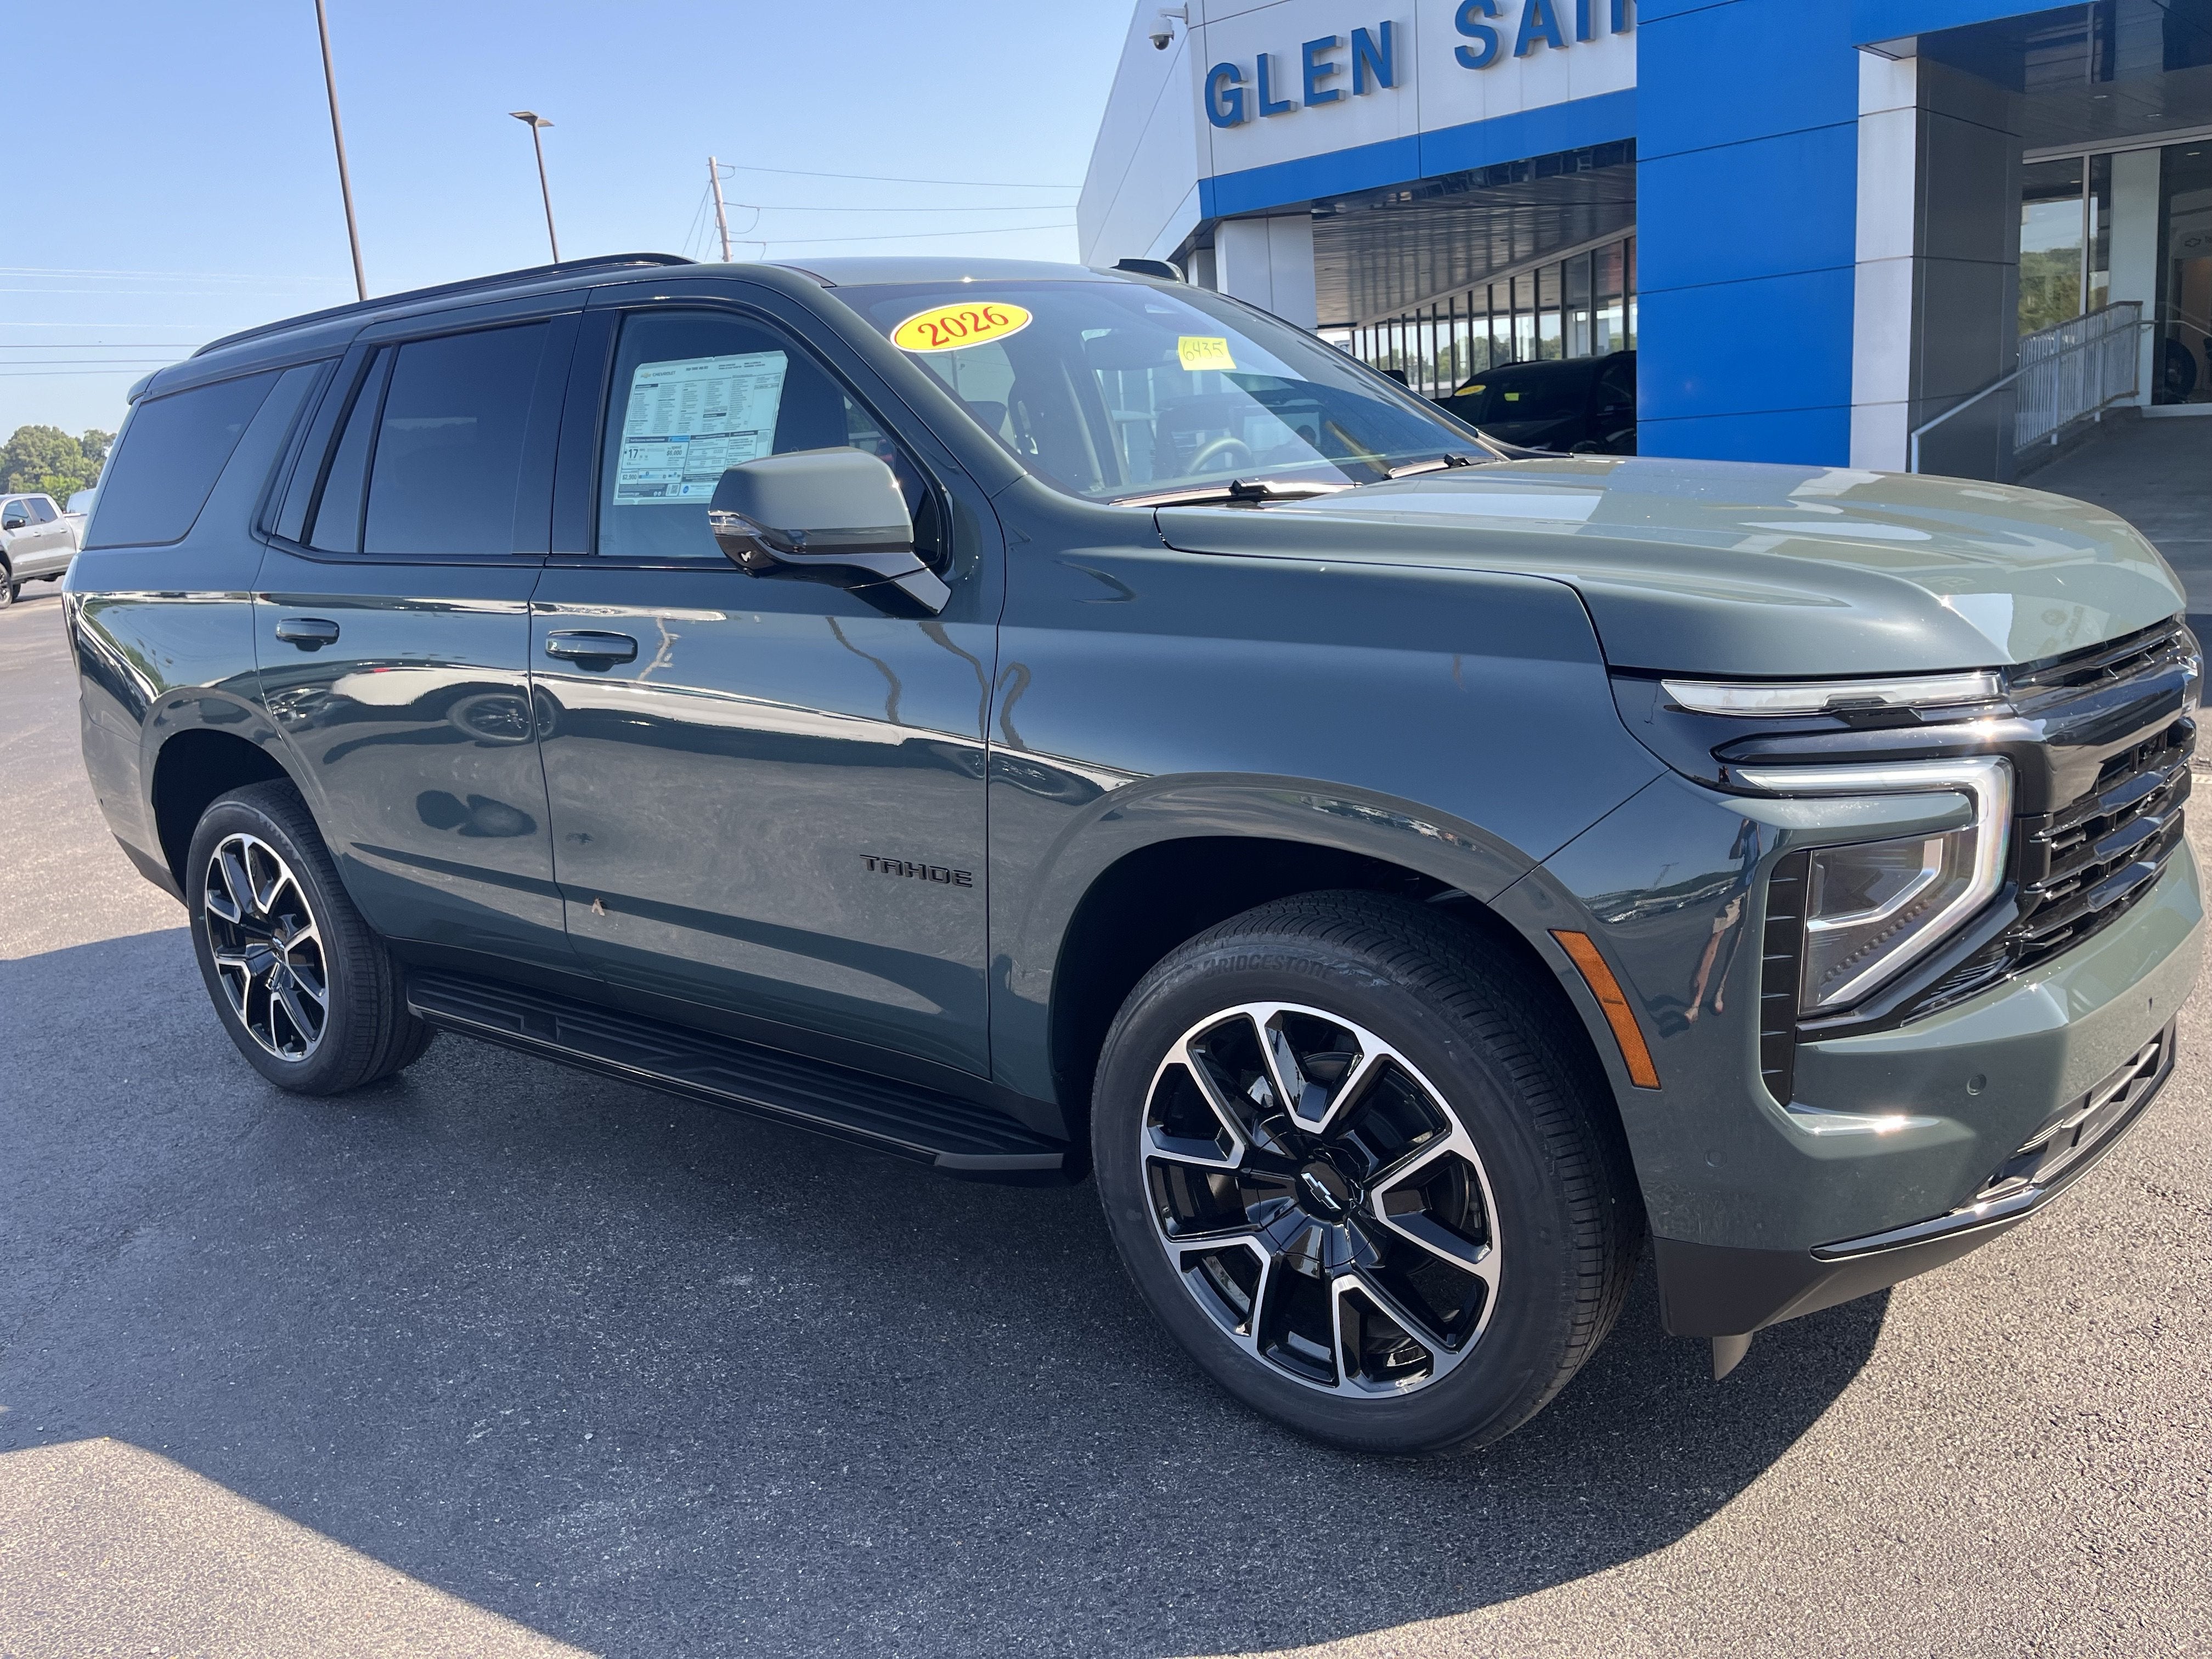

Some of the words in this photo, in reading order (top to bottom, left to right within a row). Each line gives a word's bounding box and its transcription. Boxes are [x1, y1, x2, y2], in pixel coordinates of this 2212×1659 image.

[1204, 20, 1400, 129] GLEN
[1454, 0, 1637, 70] SAI
[917, 306, 1009, 347] 2026
[1183, 340, 1224, 361] 6435
[628, 449, 639, 459] 17
[859, 854, 973, 888] TAHOE
